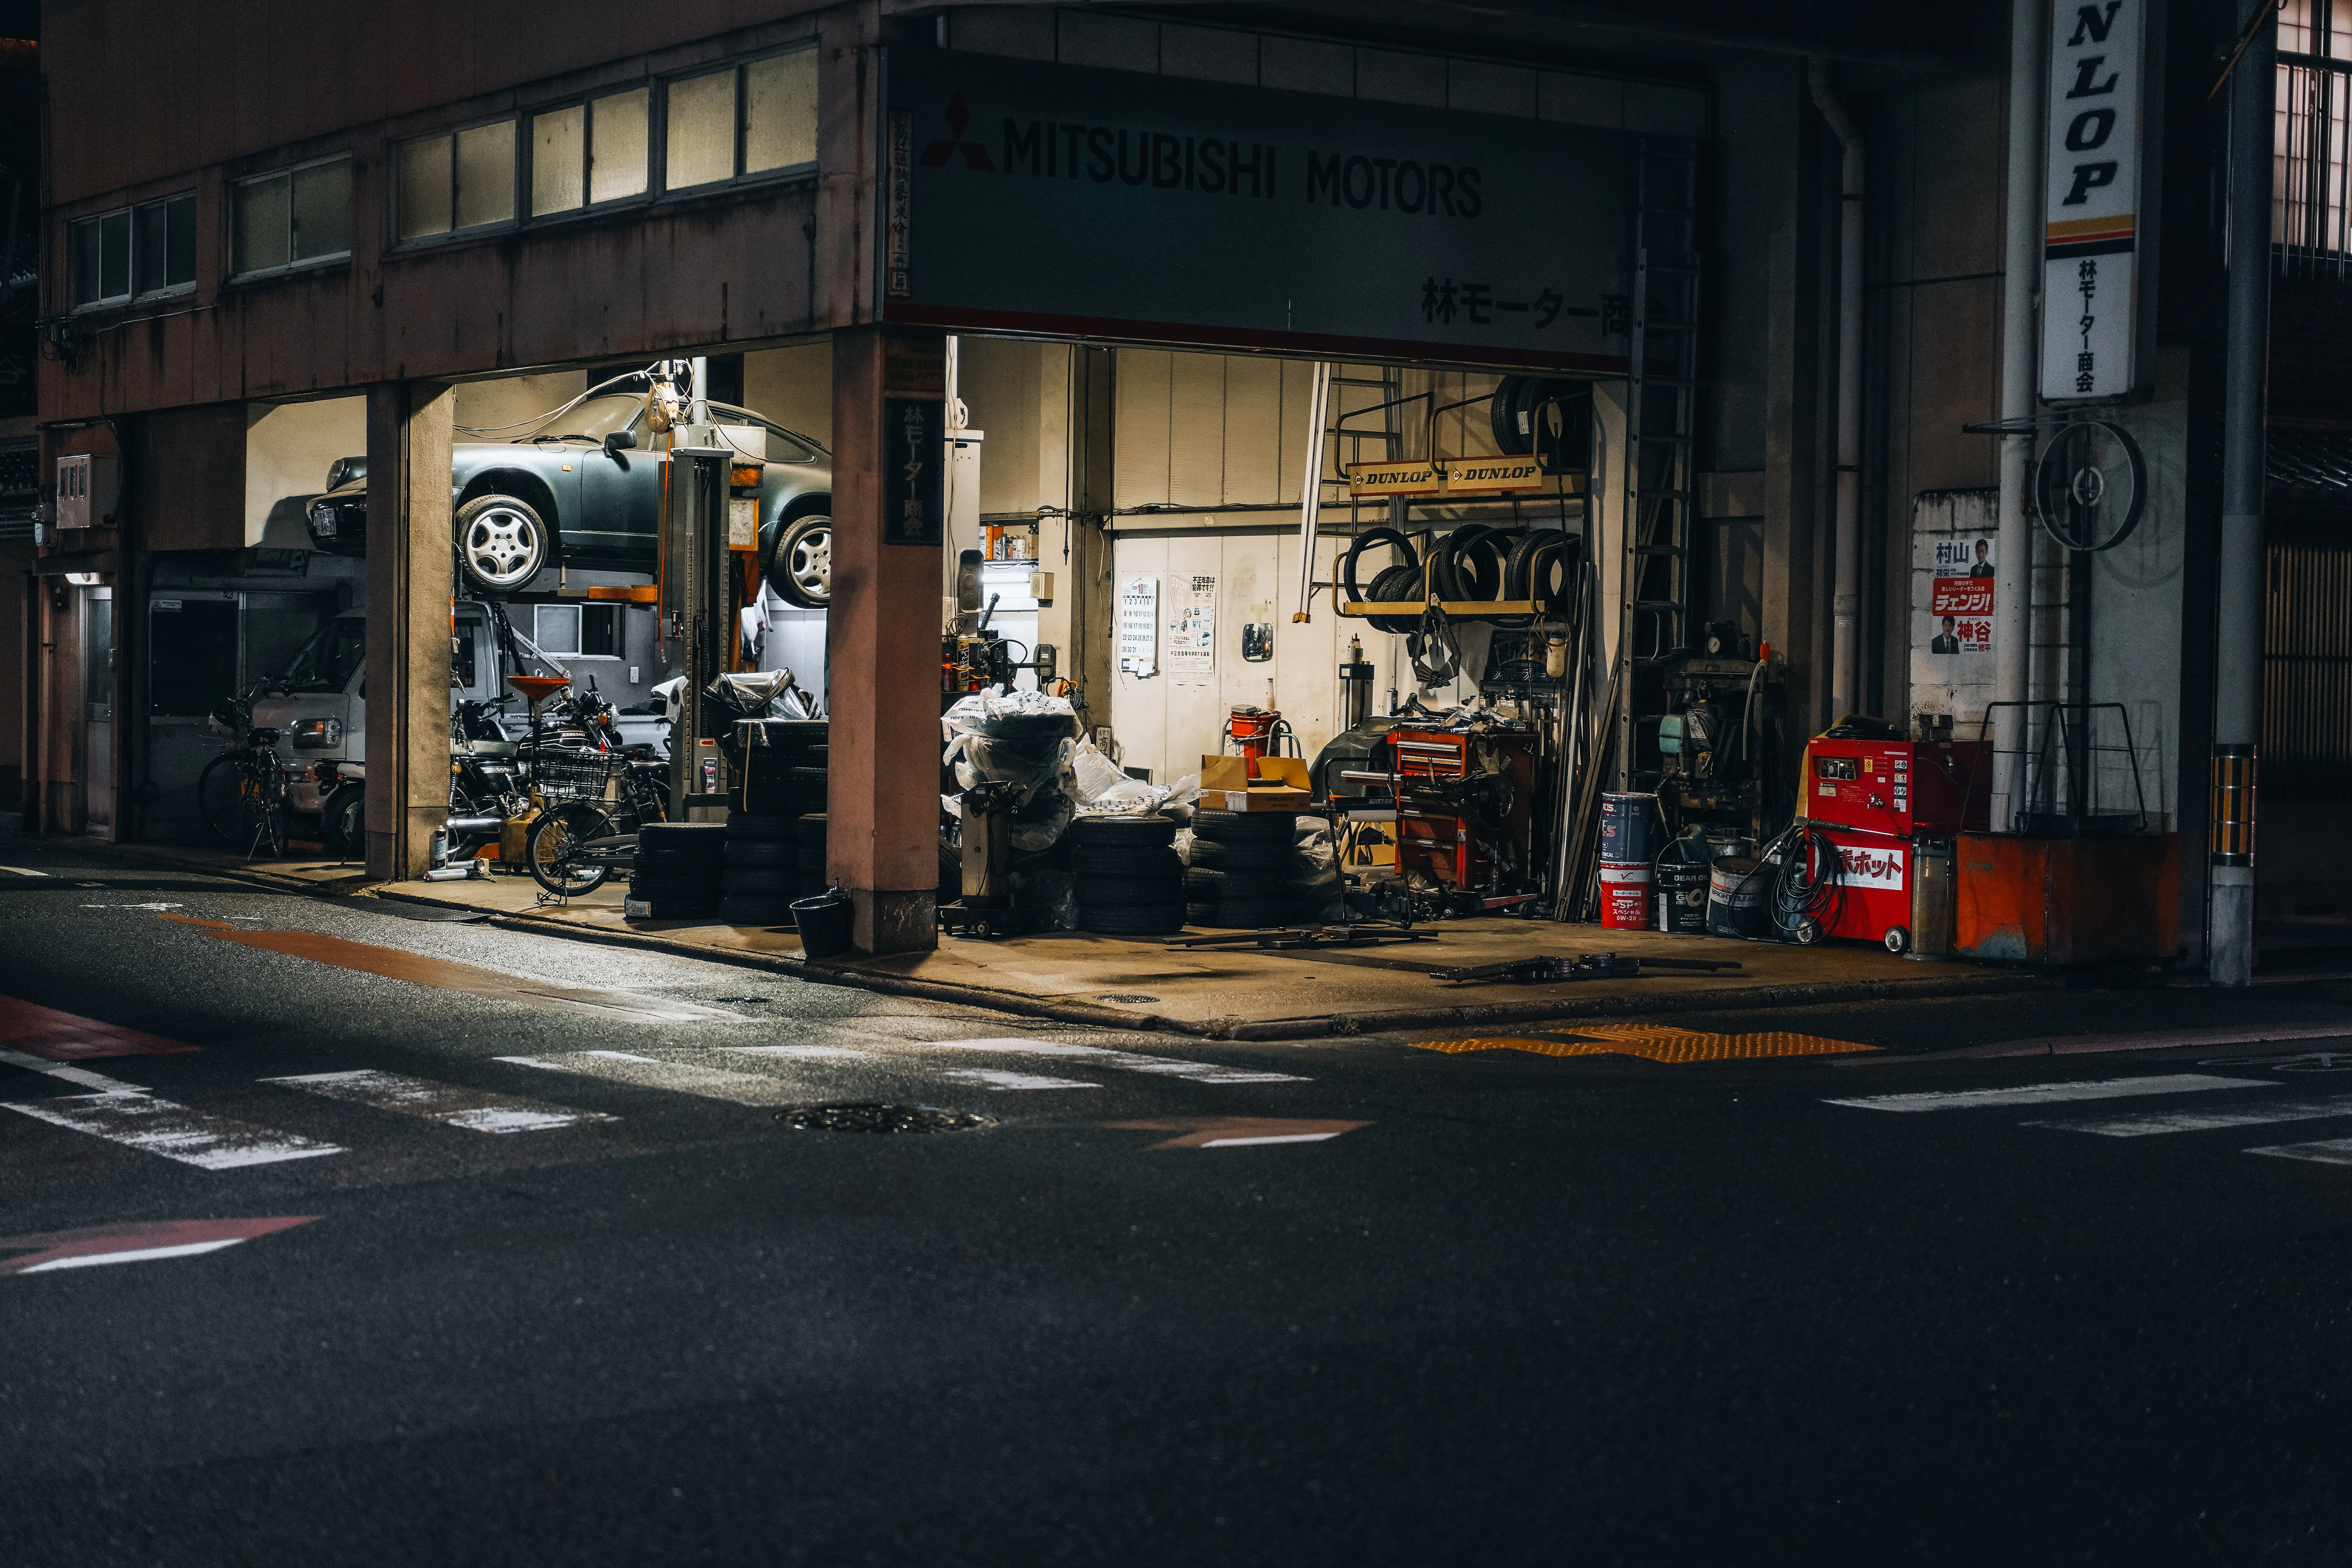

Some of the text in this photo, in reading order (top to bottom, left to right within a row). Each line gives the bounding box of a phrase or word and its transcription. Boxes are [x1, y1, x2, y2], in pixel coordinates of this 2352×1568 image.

[1004, 118, 1482, 219] MITSUBISHI MOTORS
[2076, 260, 2097, 393] 林モーター商会
[904, 405, 924, 536] 林モーター商会
[1464, 467, 1536, 480] DUNLOP
[1366, 471, 1432, 484] DUNLOP
[1936, 542, 1969, 564] 村山
[1138, 584, 1143, 594] 10
[1958, 621, 1991, 642] 神谷
[1979, 644, 1991, 653] 修平
[1492, 668, 1549, 681] ワイパーブレー
[1712, 888, 1731, 899] BRIGHT
